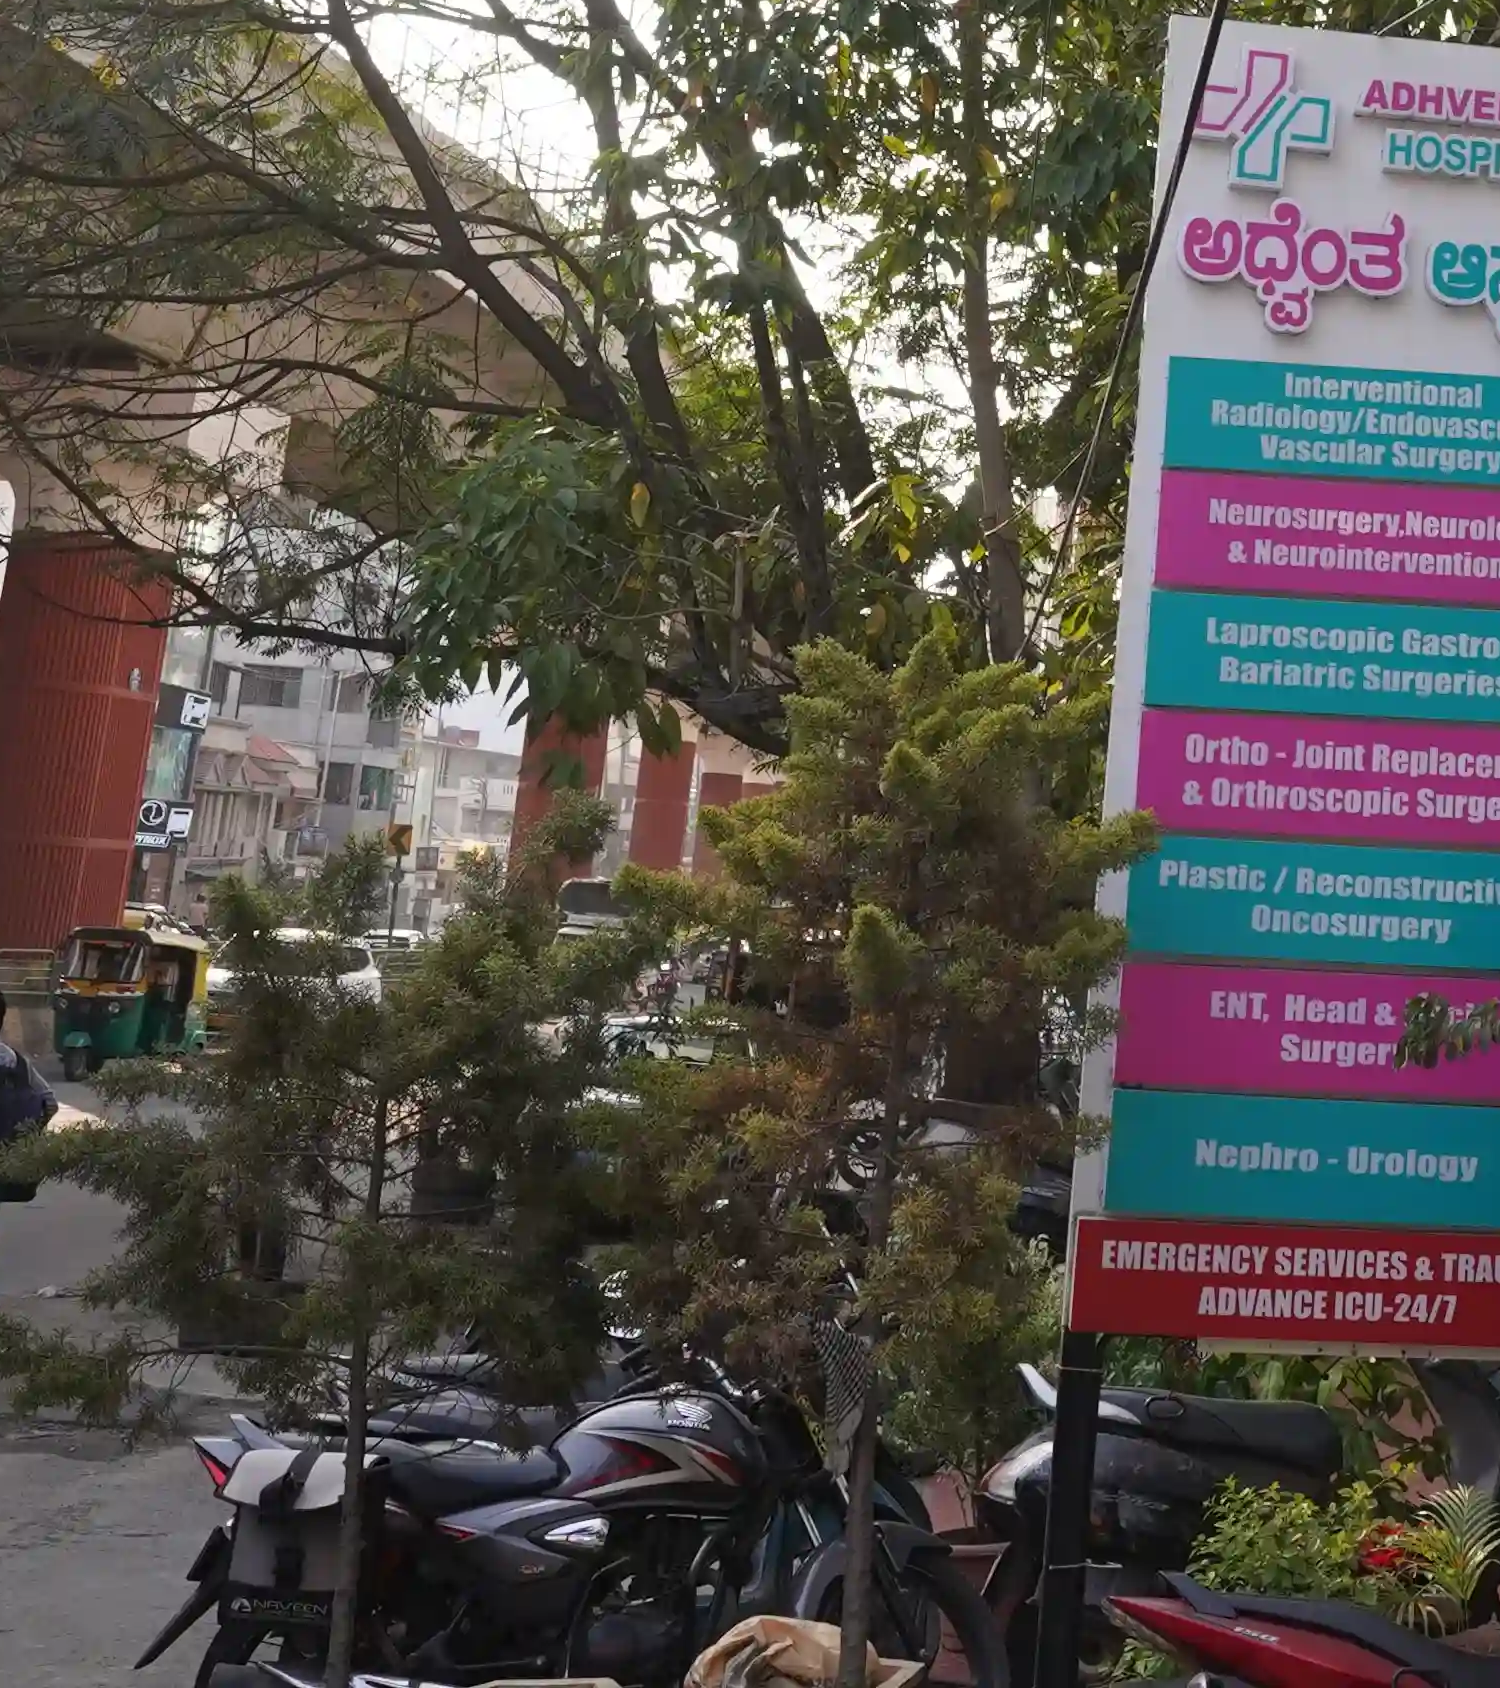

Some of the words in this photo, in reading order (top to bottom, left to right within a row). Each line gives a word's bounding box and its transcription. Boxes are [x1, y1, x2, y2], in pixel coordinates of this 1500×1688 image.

[1284, 371, 1483, 410] Interventional
[1260, 434, 1386, 466] Vascular
[1227, 541, 1248, 564] &
[1206, 617, 1395, 655] Laproscopic
[1219, 656, 1355, 691] Bariatric
[1184, 732, 1269, 766] Ortho
[1292, 739, 1365, 773] Joint
[1181, 780, 1203, 807] &
[1210, 778, 1409, 818] Orthroscopic
[1158, 859, 1266, 894] Plastic
[1251, 904, 1453, 944] Oncosurgery
[1210, 990, 1270, 1024] ENT,
[1284, 993, 1366, 1026] Head
[1374, 1000, 1397, 1027] &
[1280, 1032, 1398, 1069] Surger
[1195, 1138, 1319, 1173] Nephro
[1347, 1145, 1479, 1183] Urology
[1101, 1239, 1270, 1276] EMERGENCY
[1274, 1246, 1408, 1282] SERVICES
[1414, 1256, 1434, 1282] &
[1197, 1285, 1328, 1320] ADVANCE
[1333, 1290, 1458, 1325] ICU-24/7
[666, 1418, 711, 1431] HONDA
[252, 1598, 329, 1616] NAVEEN
